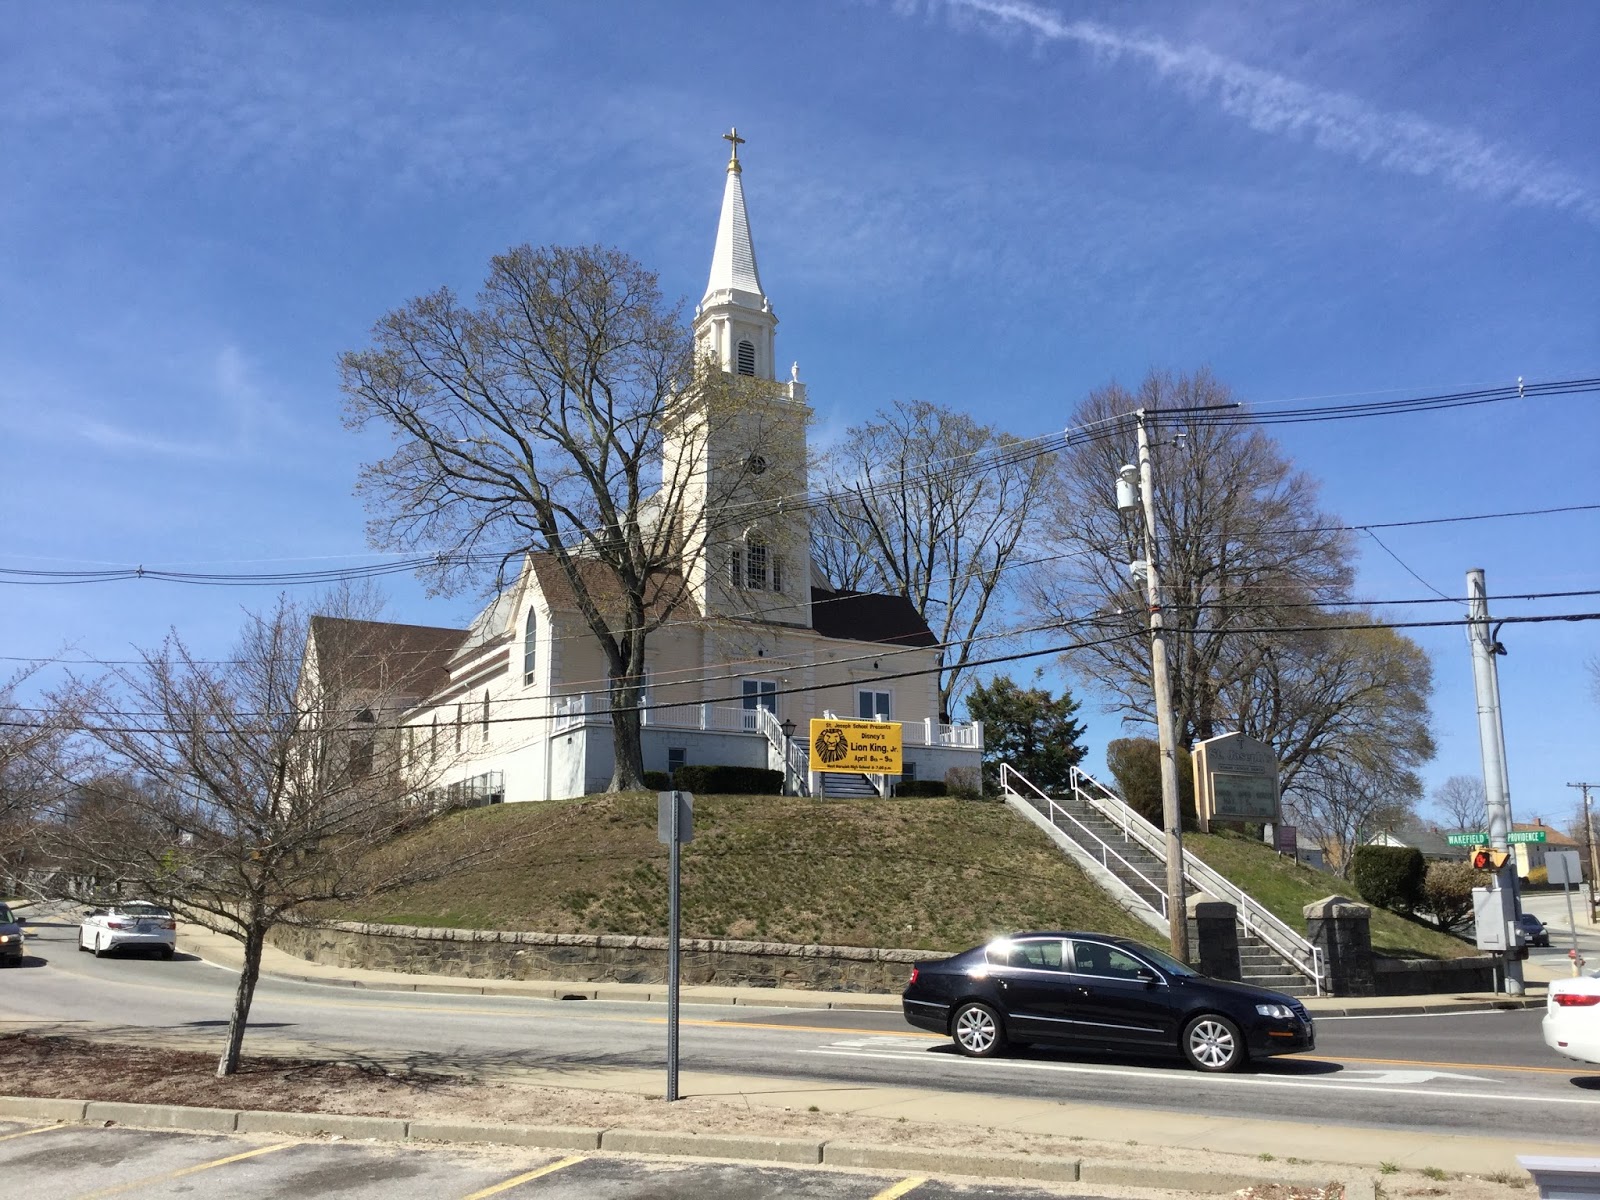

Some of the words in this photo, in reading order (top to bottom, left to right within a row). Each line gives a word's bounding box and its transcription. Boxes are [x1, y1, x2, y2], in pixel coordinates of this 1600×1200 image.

[851, 742, 867, 751] Lion
[1448, 834, 1484, 844] WAKEFIELD
[1508, 832, 1538, 842] PROVIDENCE
